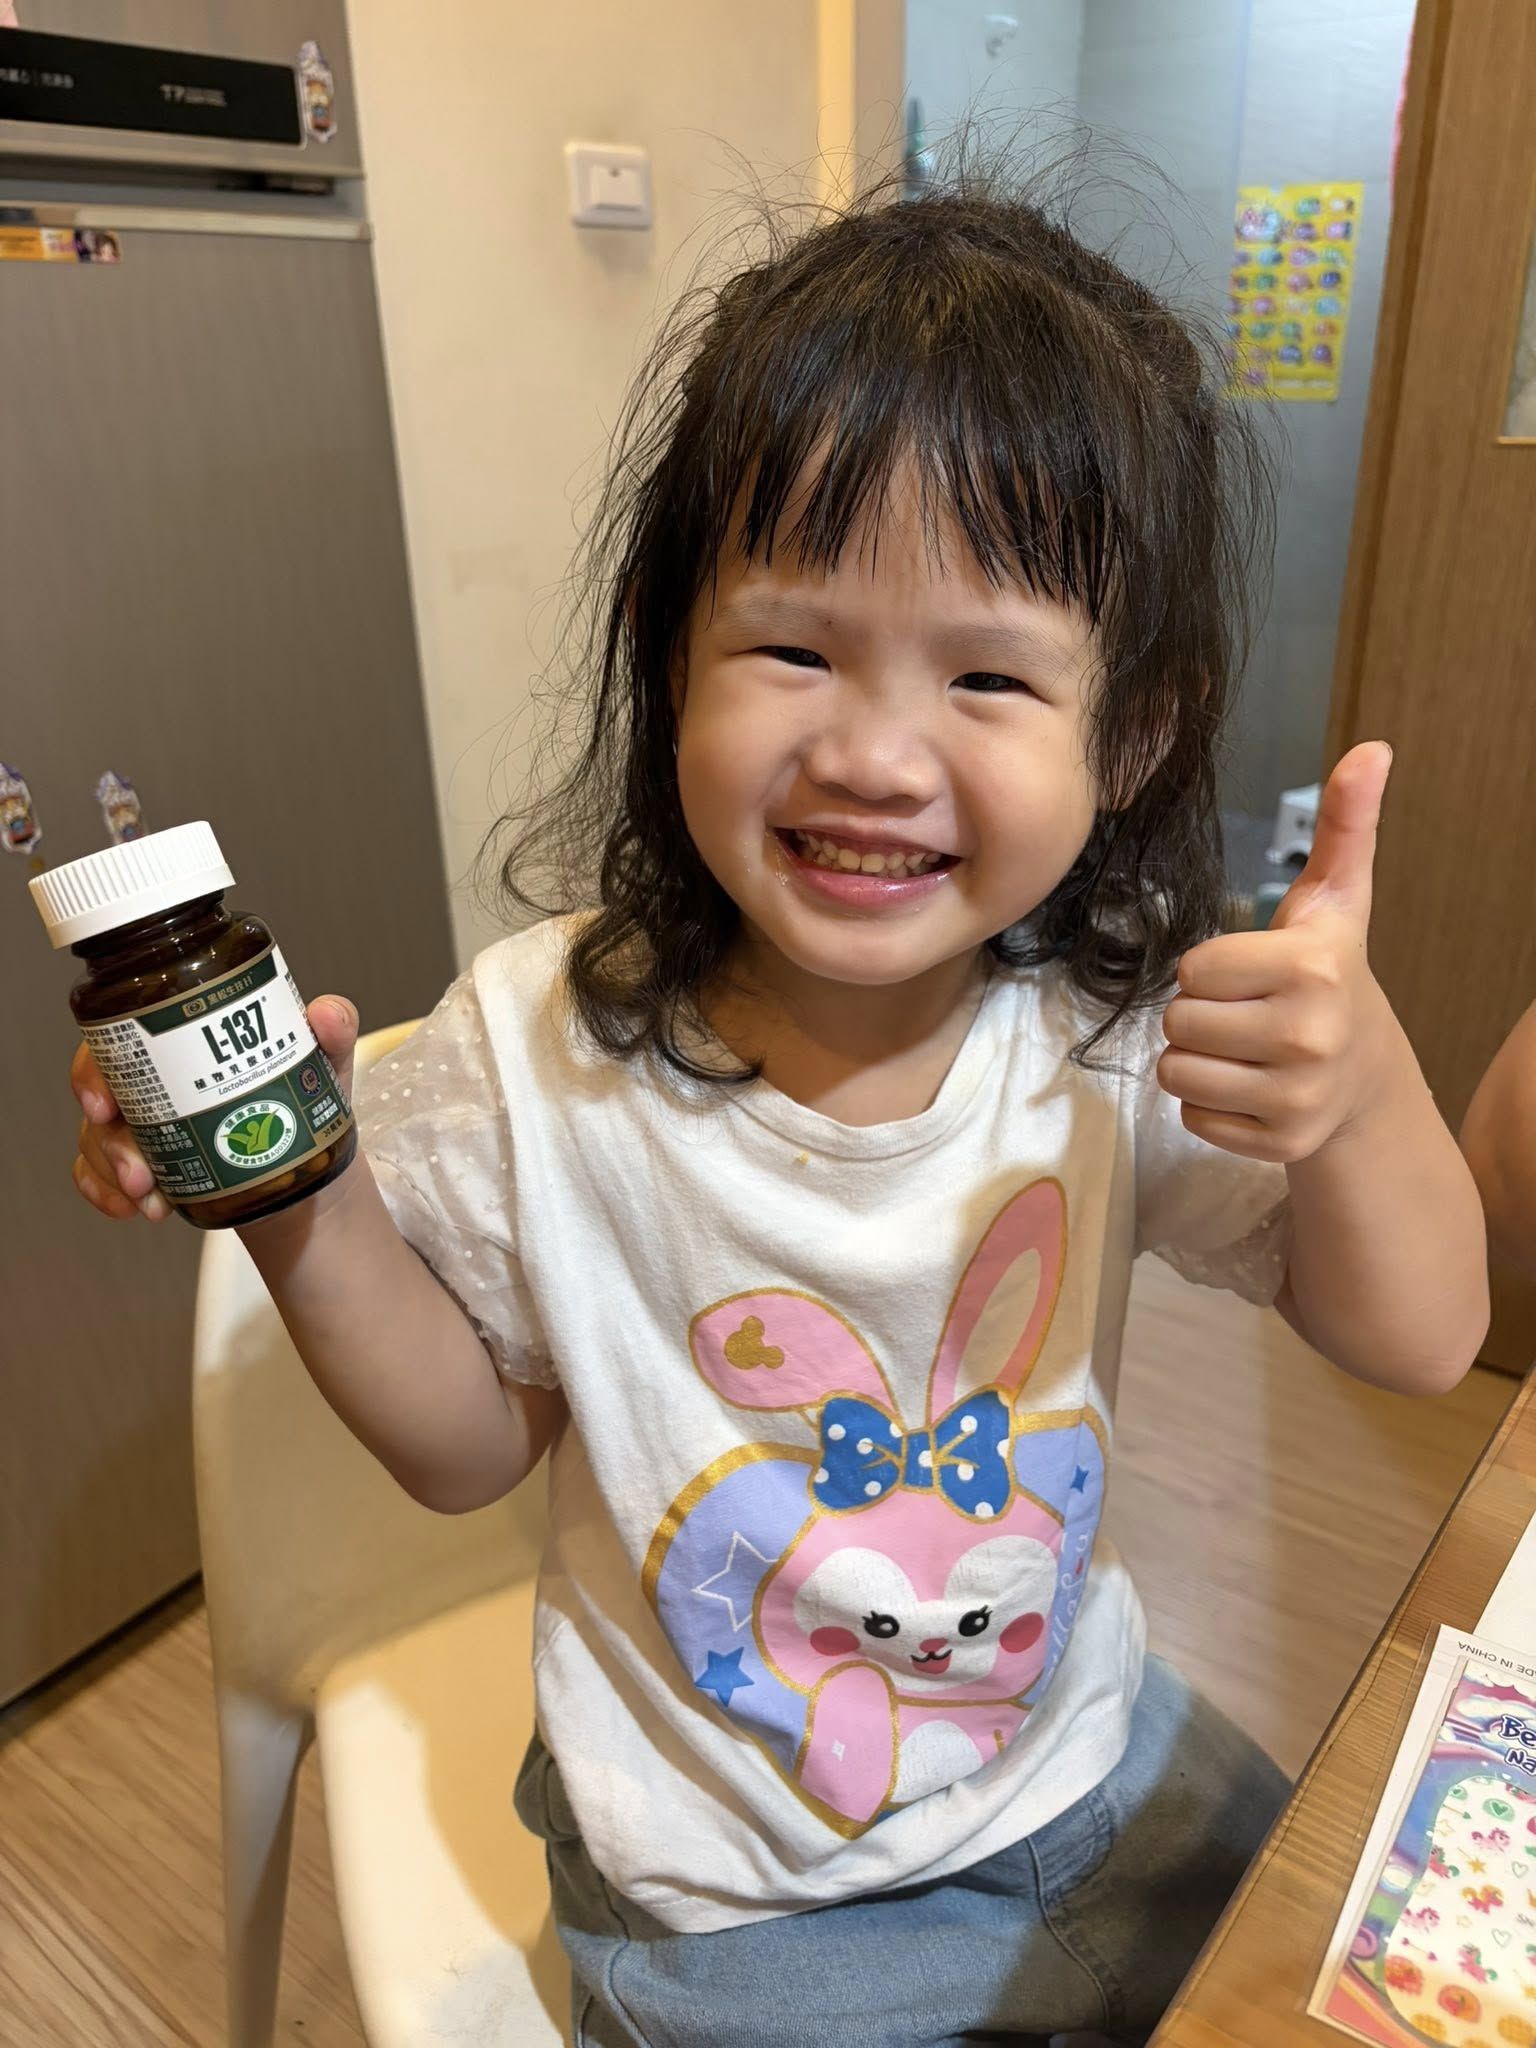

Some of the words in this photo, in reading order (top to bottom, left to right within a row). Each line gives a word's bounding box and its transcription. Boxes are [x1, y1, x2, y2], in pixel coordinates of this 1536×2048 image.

[218, 1068, 267, 1095] Lactobacillus
[267, 1050, 297, 1073] plantarum
[224, 1103, 270, 1130] 健康食品
[1458, 1641, 1497, 1662] CHINA
[1500, 1658, 1513, 1668] IN
[1516, 1664, 1536, 1677] DE
[1501, 1715, 1536, 1747] Be
[1507, 1750, 1536, 1774] Na
